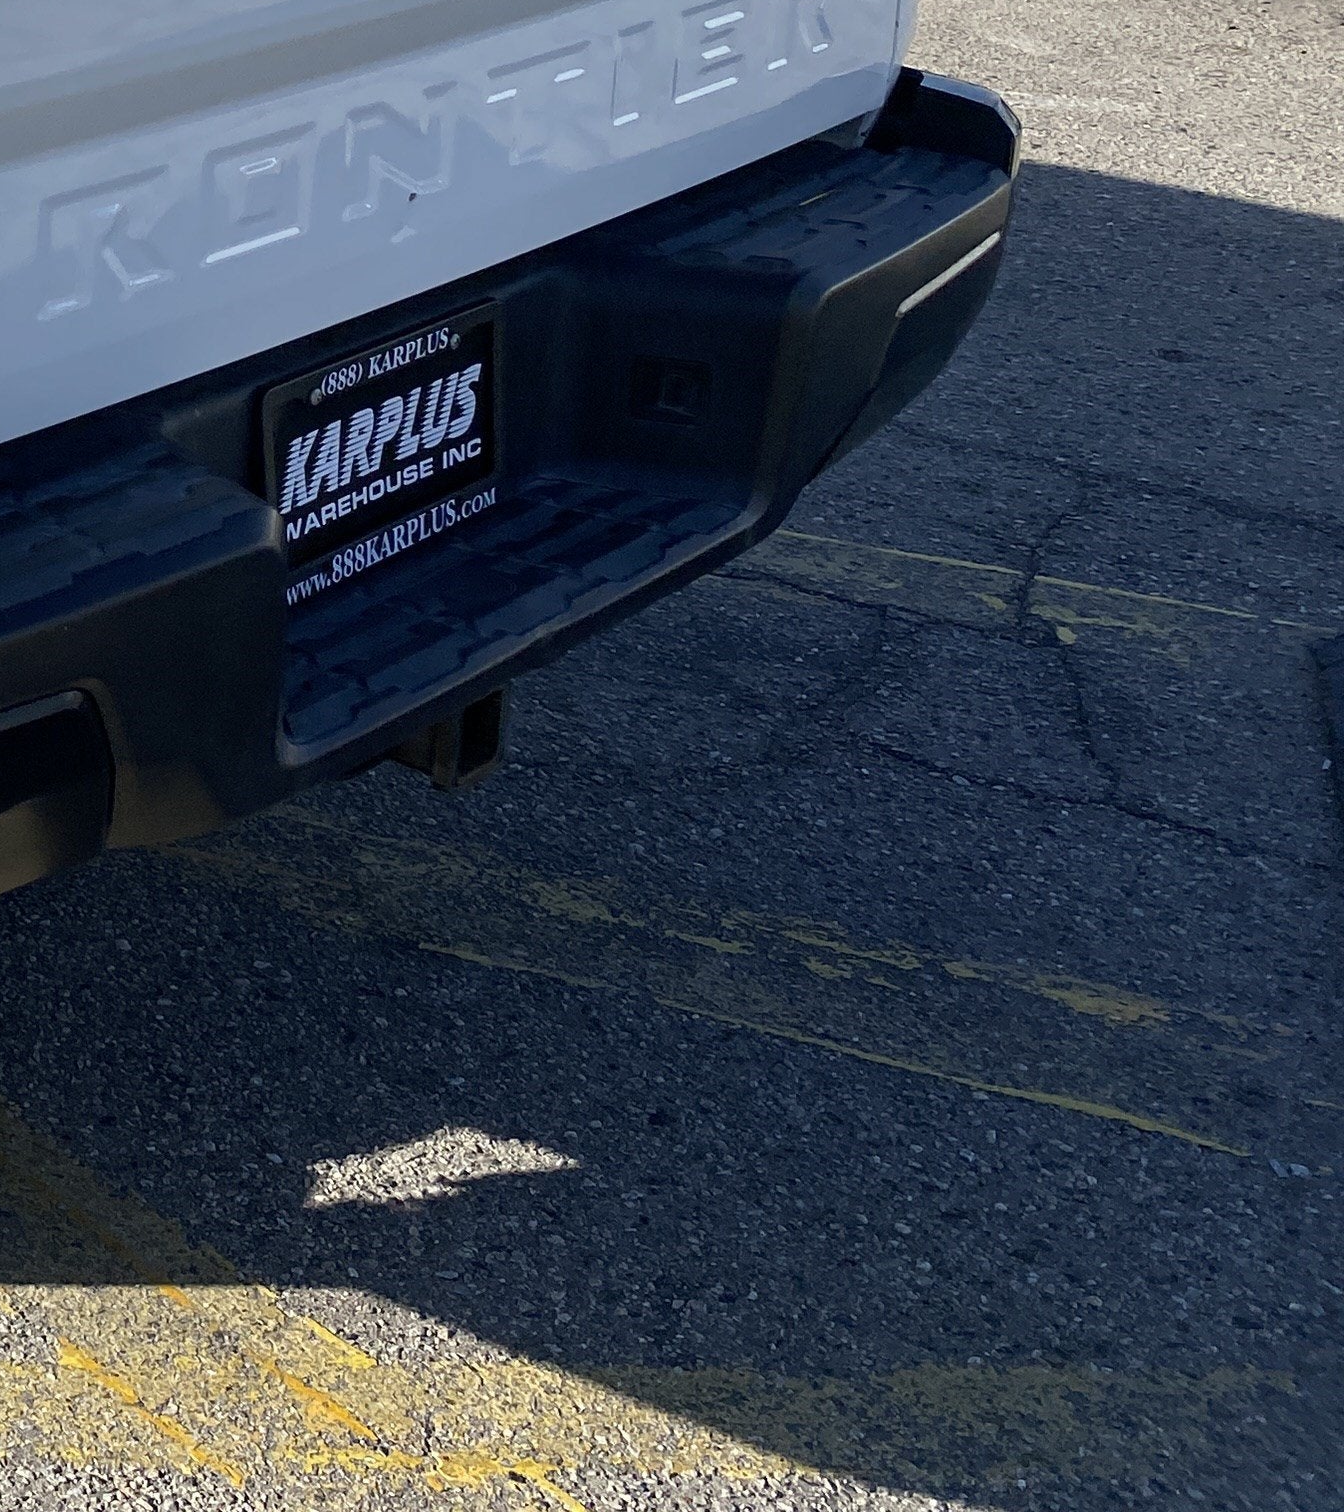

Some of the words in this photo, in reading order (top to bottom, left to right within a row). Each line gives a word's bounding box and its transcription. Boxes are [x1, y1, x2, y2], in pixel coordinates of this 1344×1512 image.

[320, 362, 363, 397] (888)
[367, 326, 450, 379] KARPLUS
[279, 362, 483, 516] KARPLUS
[442, 437, 483, 470] INC
